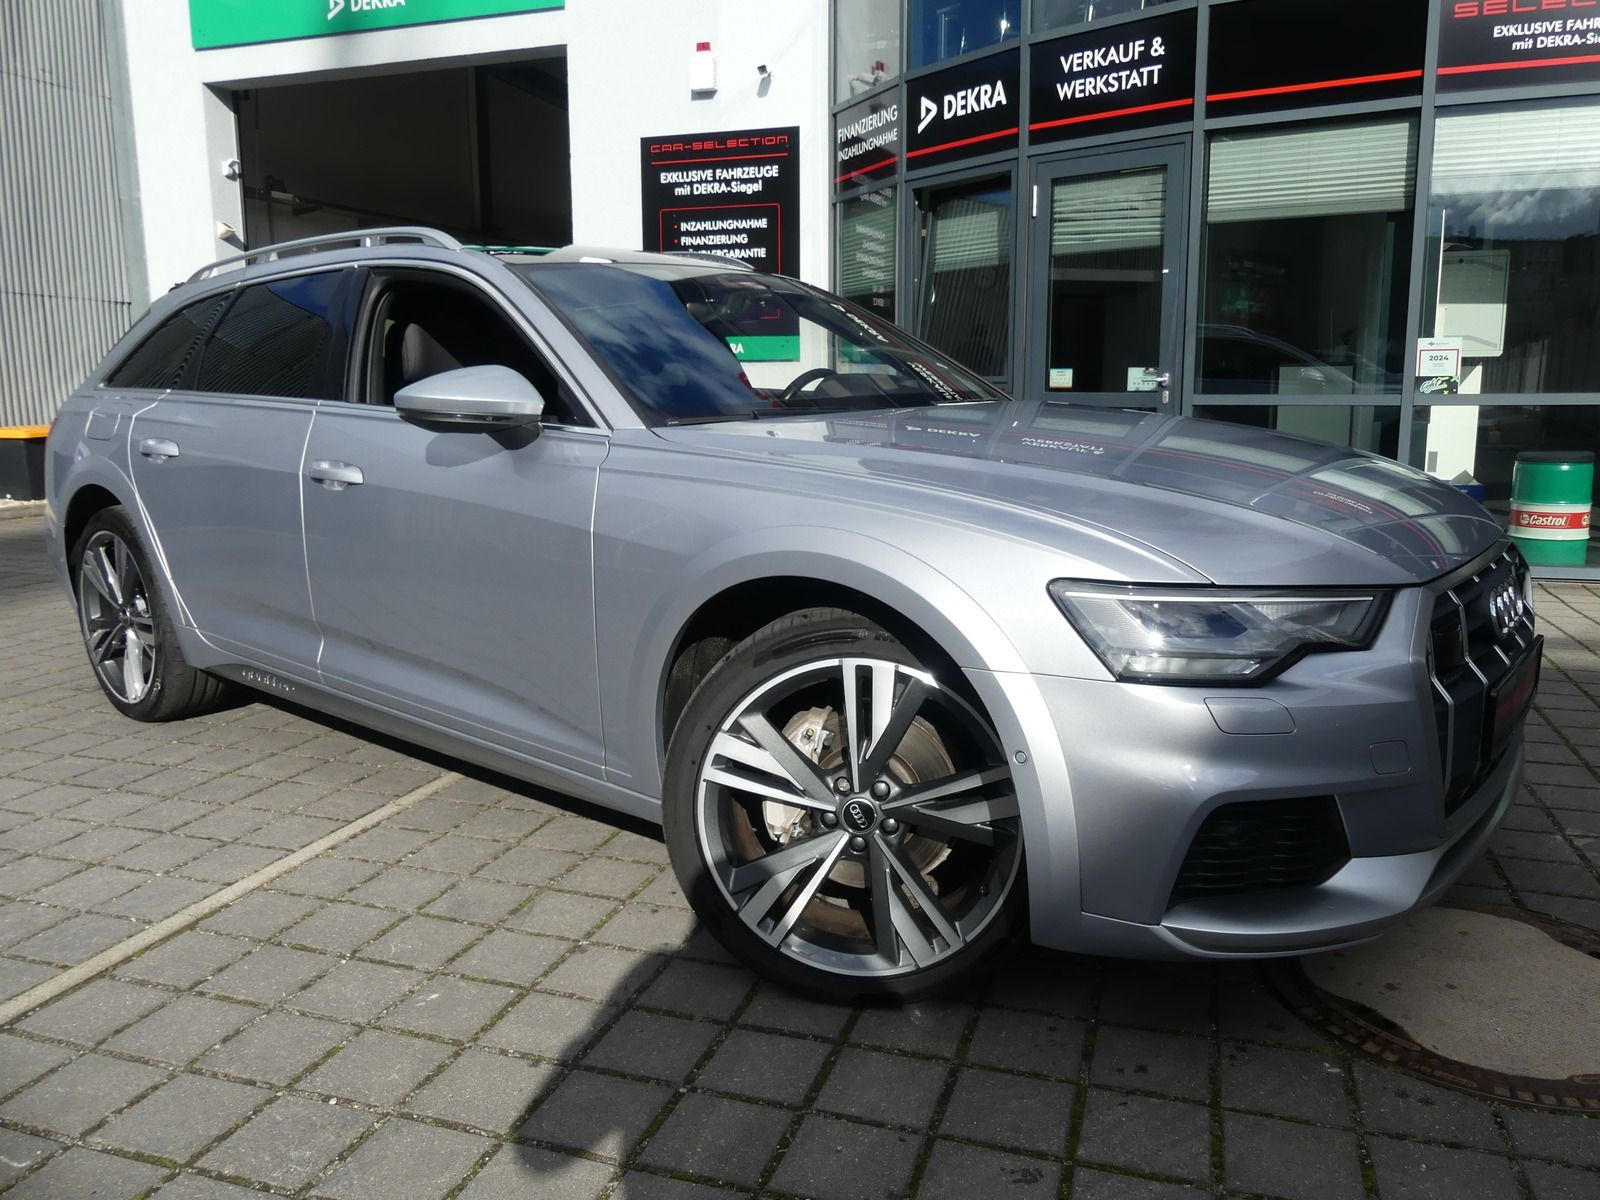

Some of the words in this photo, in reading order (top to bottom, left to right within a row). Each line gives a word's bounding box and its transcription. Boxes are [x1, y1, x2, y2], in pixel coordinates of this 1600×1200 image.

[1493, 20, 1563, 38] EXKLUSIVE
[1512, 38, 1534, 51] mit
[1060, 39, 1145, 74] VERKAUF
[1150, 36, 1165, 57] &
[1056, 64, 1163, 101] WERKSTATT
[943, 80, 1007, 120] DEKRA
[837, 104, 898, 144] FINANZIERUNG
[660, 169, 713, 184] EXKLUSIVE
[715, 165, 779, 180] FAHRZEUGE
[674, 184, 691, 196] mit
[693, 180, 762, 195] DEKRA-Siegel
[680, 218, 768, 232] INZAHLUNGNAHME
[680, 234, 748, 247] FINANZIERUNG
[1529, 514, 1567, 526] Castrol
